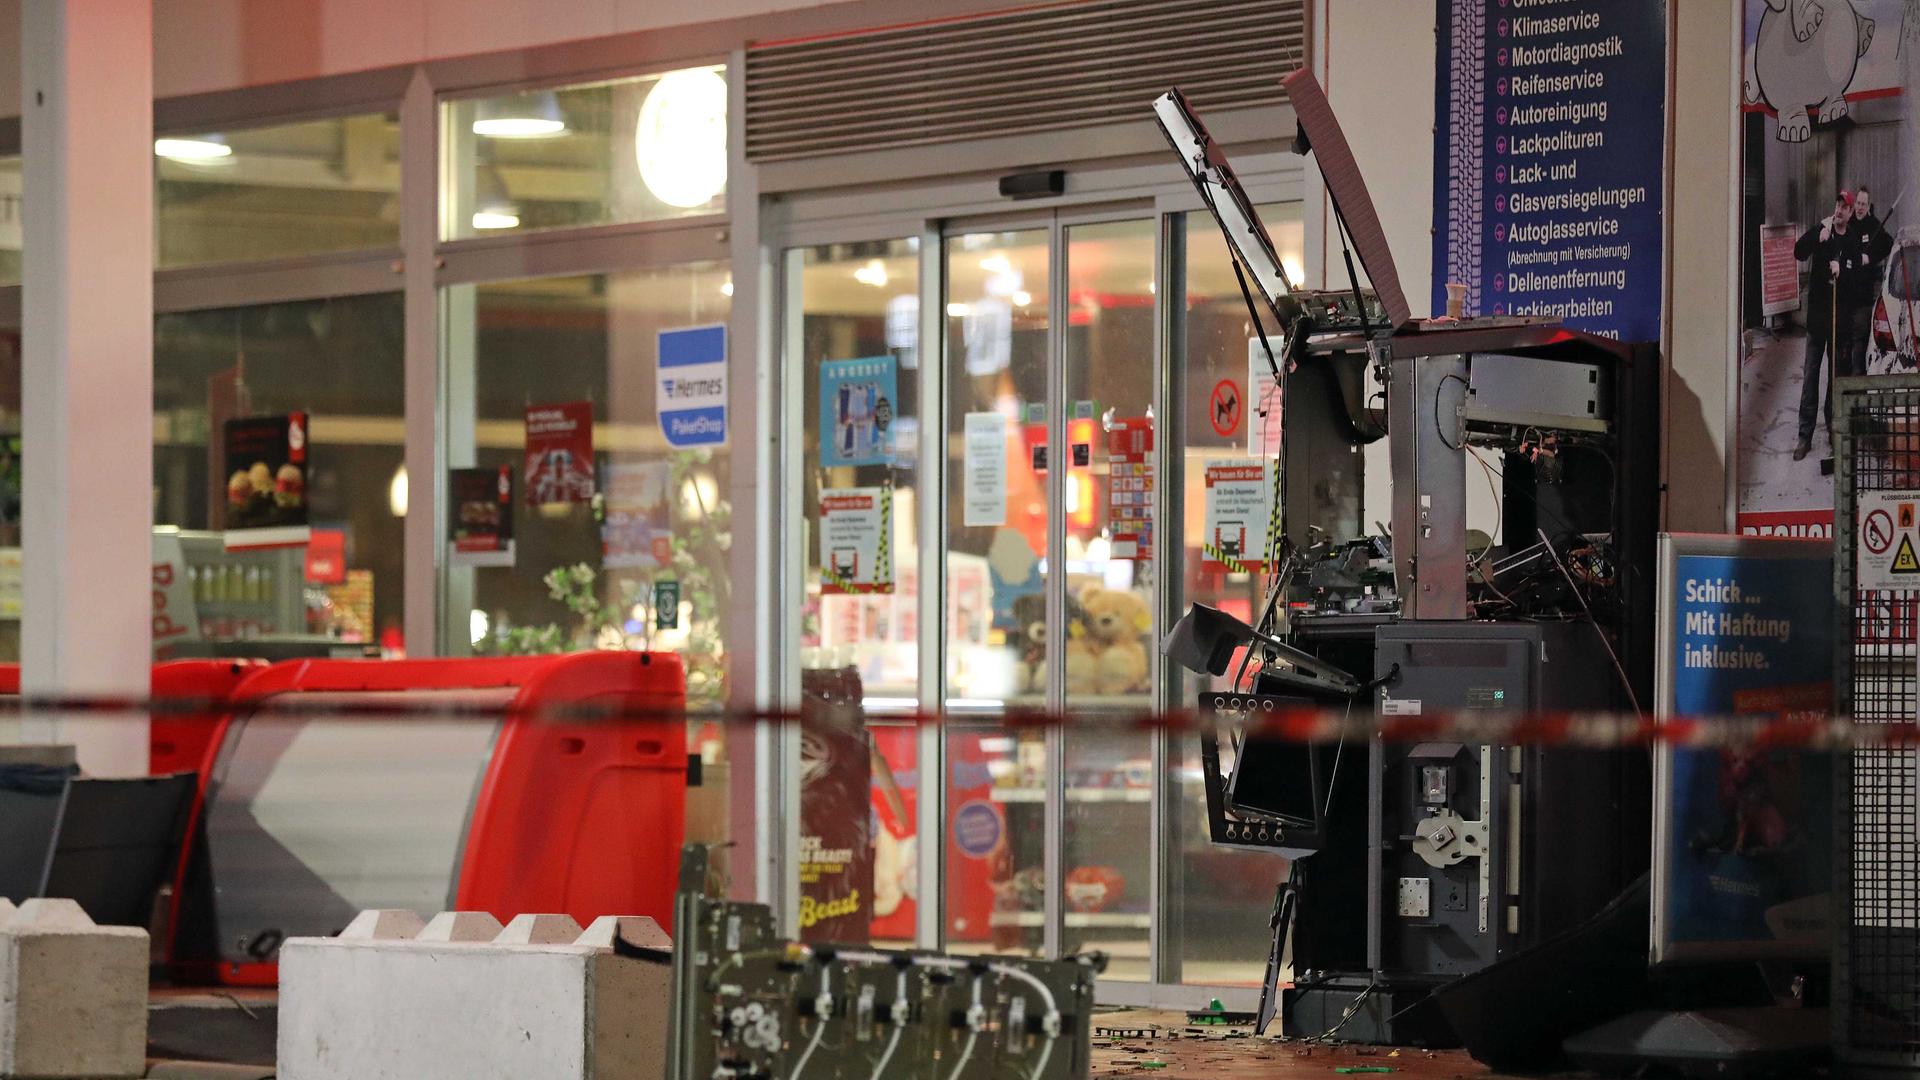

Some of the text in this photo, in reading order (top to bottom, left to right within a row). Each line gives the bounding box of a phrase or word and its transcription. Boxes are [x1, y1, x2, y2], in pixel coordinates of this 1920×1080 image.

[1513, 10, 1600, 37] Klimaservice
[1512, 36, 1623, 67] Motordiagnostik
[1511, 69, 1603, 96] Reifenservice
[1510, 100, 1607, 126] Autoreinigung
[1511, 130, 1603, 156] Lackpolituren
[1510, 159, 1577, 184] Lack- und
[1509, 186, 1645, 214] Glasversiegelungen
[1508, 216, 1619, 245] Autoglasservice
[1507, 242, 1631, 268] (Abrechnung mit Versicherung)
[1508, 268, 1626, 293] Dellenentfernung
[675, 377, 723, 398] Hermes
[1900, 553, 1911, 566] EX
[1686, 578, 1741, 604] Schick
[1685, 610, 1790, 643] Mit Haftung
[1684, 643, 1770, 669] inklusive.
[798, 889, 860, 929] Beast
